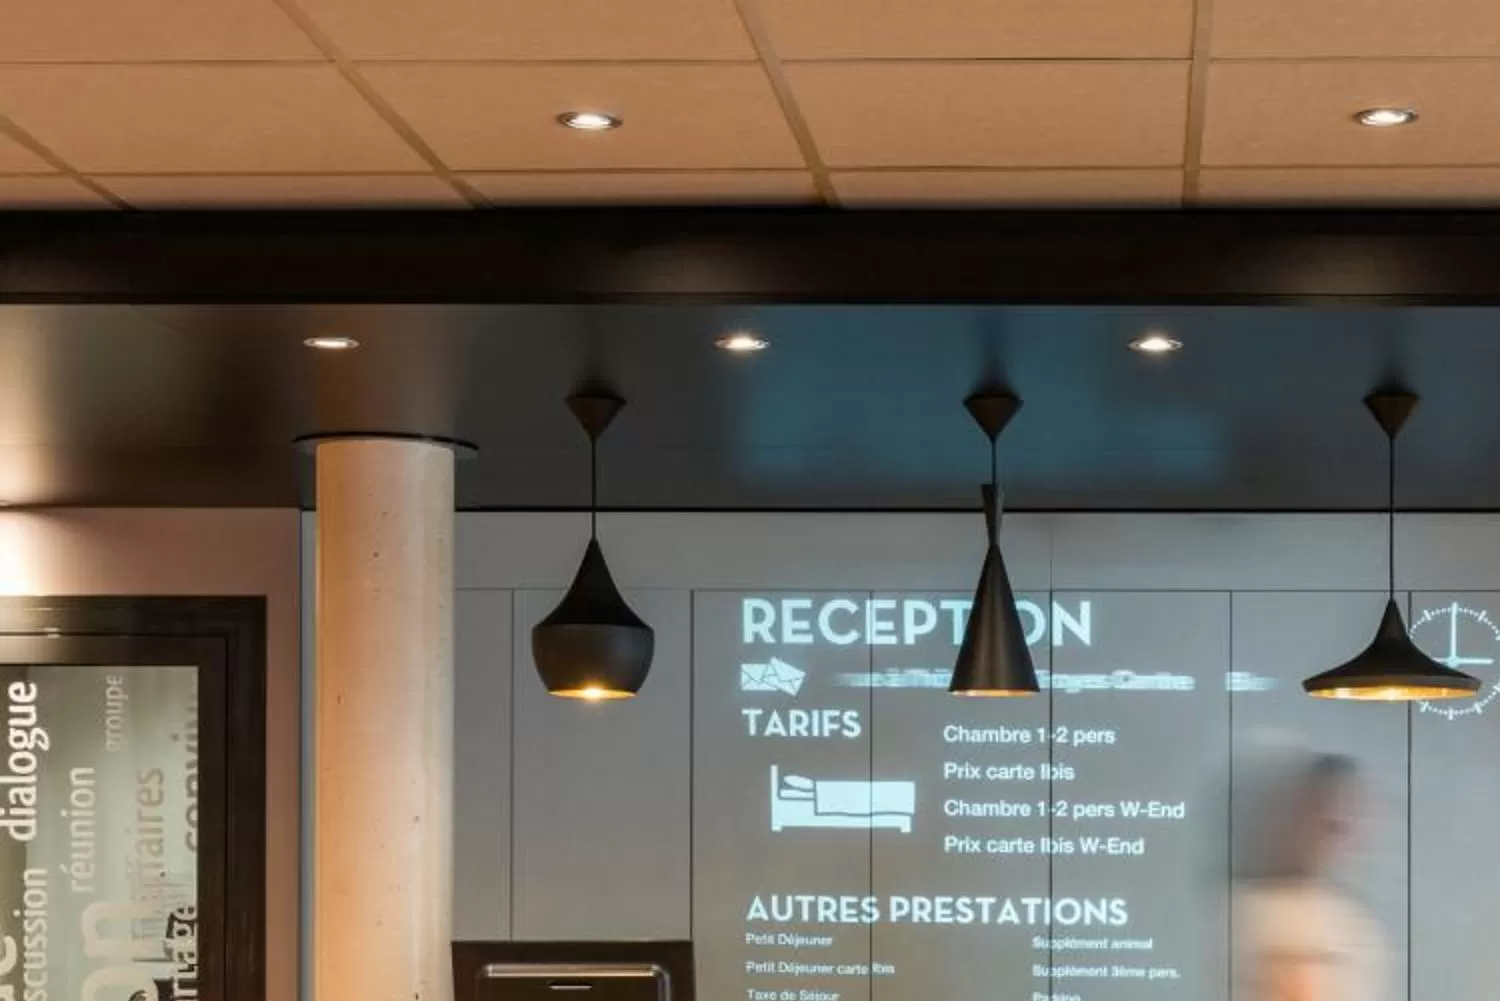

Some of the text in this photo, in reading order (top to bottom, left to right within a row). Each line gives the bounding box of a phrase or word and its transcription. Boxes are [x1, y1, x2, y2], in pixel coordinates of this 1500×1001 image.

[742, 598, 1092, 647] RECEPTON
[741, 708, 863, 738] TARIFS
[943, 725, 1117, 747] Chambre 1-2 pers
[0, 680, 50, 842] dialogue
[943, 762, 981, 780] Prix
[985, 764, 1035, 781] carte
[943, 799, 1186, 821] Chambre 1-2 pers W-End
[60, 767, 96, 894] réunion
[944, 836, 981, 853] Prix
[986, 838, 1035, 854] carte
[1080, 837, 1145, 856] W-End
[745, 895, 1129, 926] AUTRES PRESTATIONS
[745, 932, 775, 945] Petit
[745, 961, 776, 974] Petit
[779, 990, 797, 1001] de
